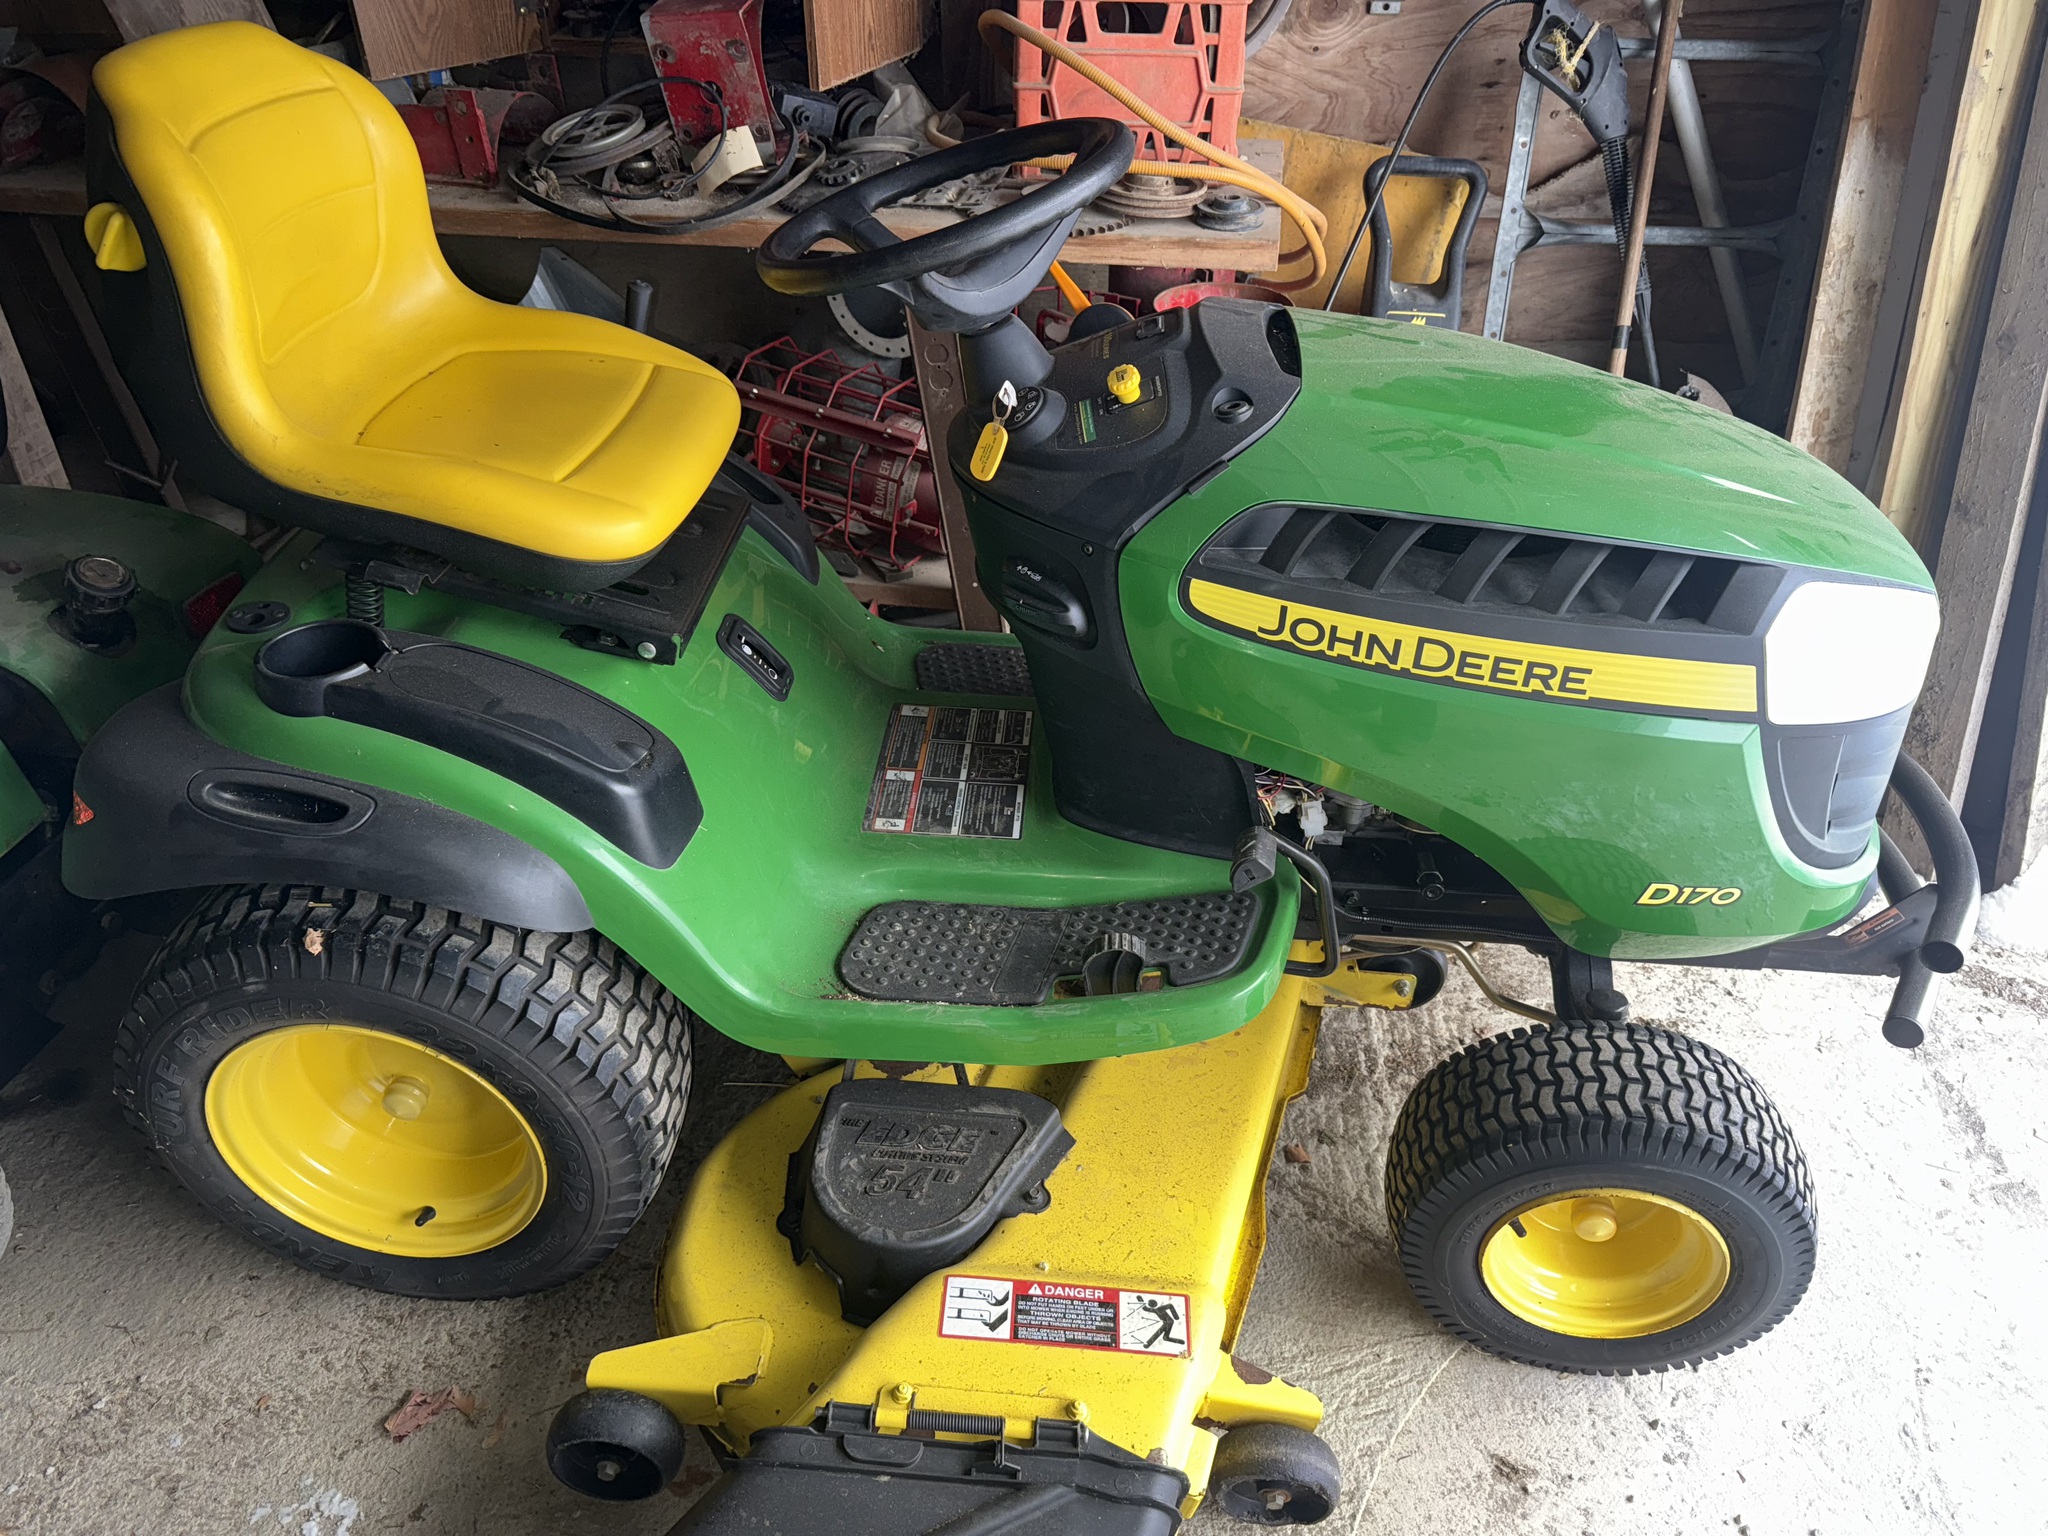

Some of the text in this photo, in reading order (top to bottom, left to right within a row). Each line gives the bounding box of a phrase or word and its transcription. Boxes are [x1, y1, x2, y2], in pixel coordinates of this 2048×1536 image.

[1257, 605, 1593, 695] JOHN DEERE
[1634, 881, 1743, 906] D170
[173, 997, 332, 1059] RIDER
[856, 1120, 984, 1153] EDGE
[1045, 1286, 1104, 1299] DANGER
